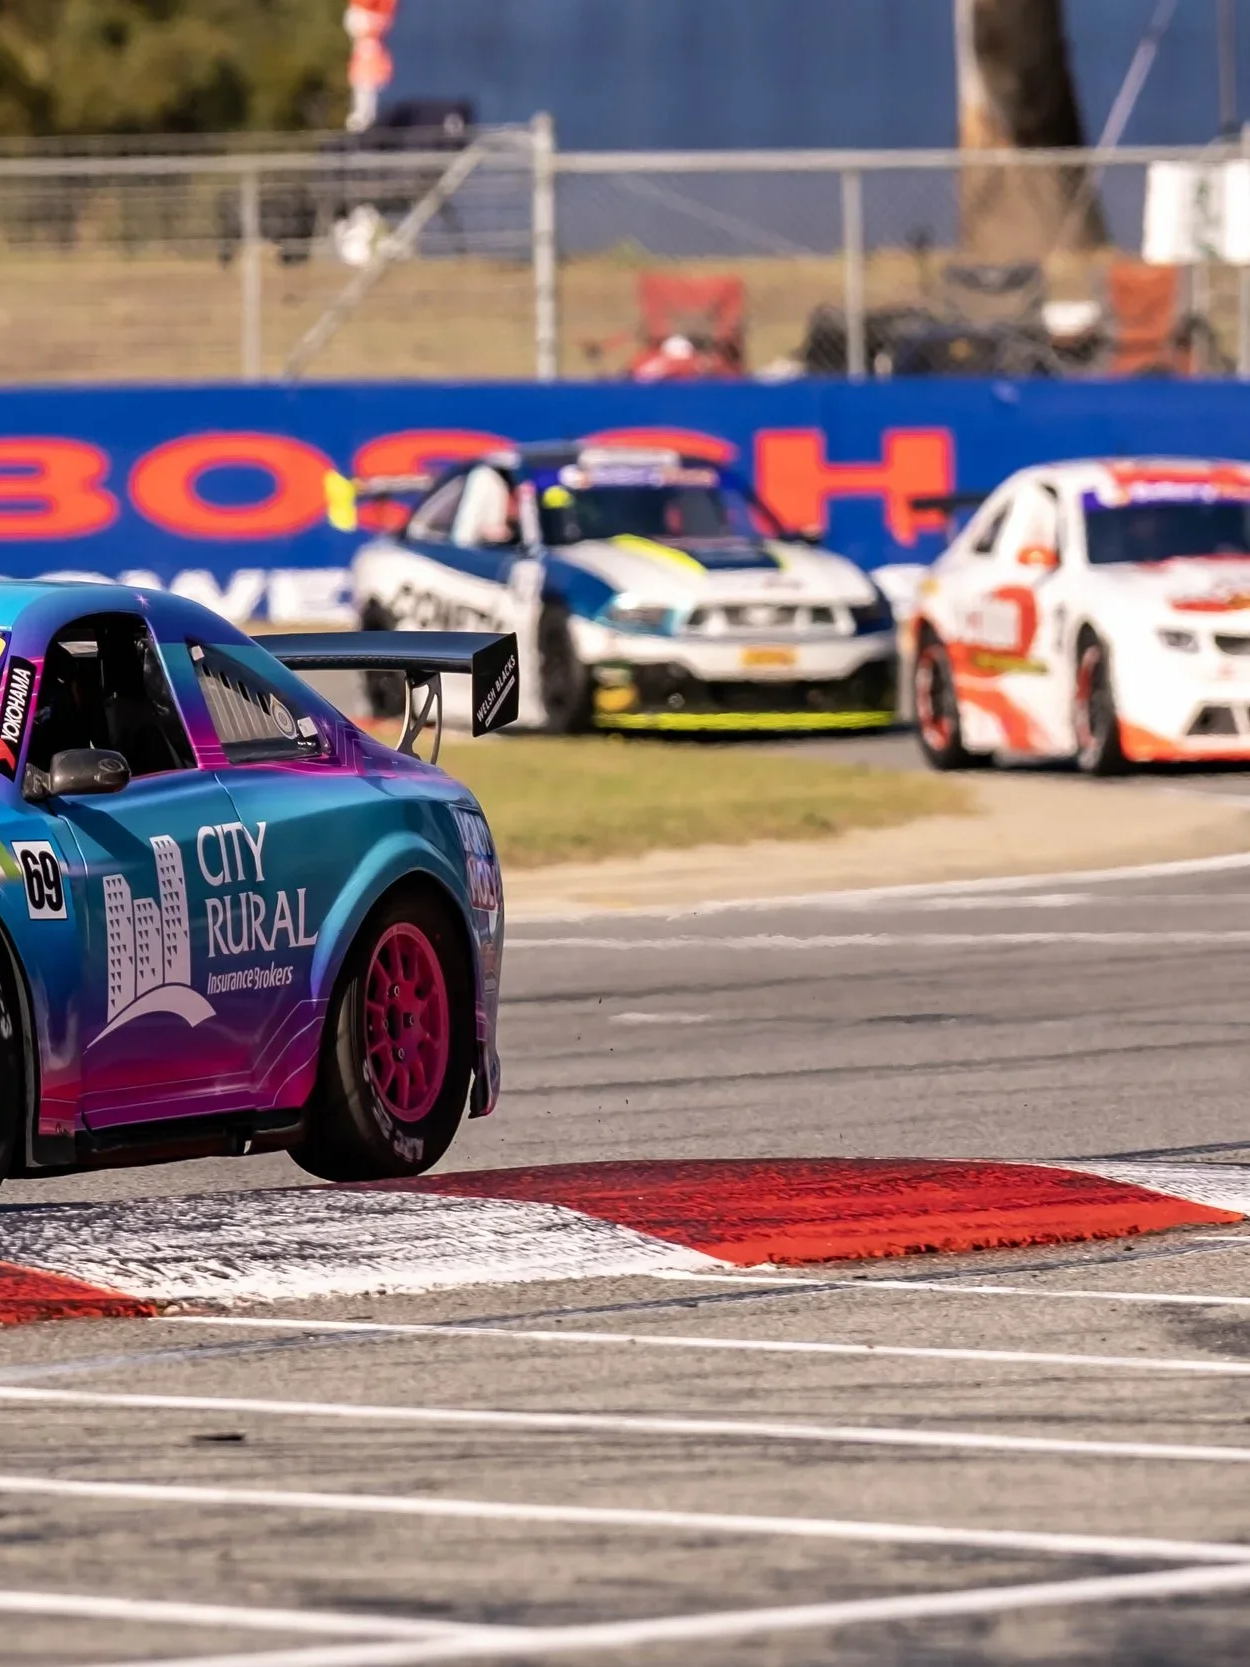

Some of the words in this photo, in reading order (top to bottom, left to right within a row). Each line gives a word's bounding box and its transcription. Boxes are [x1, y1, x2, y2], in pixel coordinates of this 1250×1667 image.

[0, 667, 31, 743] YOKOHAMA
[476, 687, 497, 723] WELSH
[495, 654, 516, 693] BLACKS
[20, 849, 63, 911] 69
[197, 821, 266, 886] CITY
[205, 888, 318, 958] RURAL
